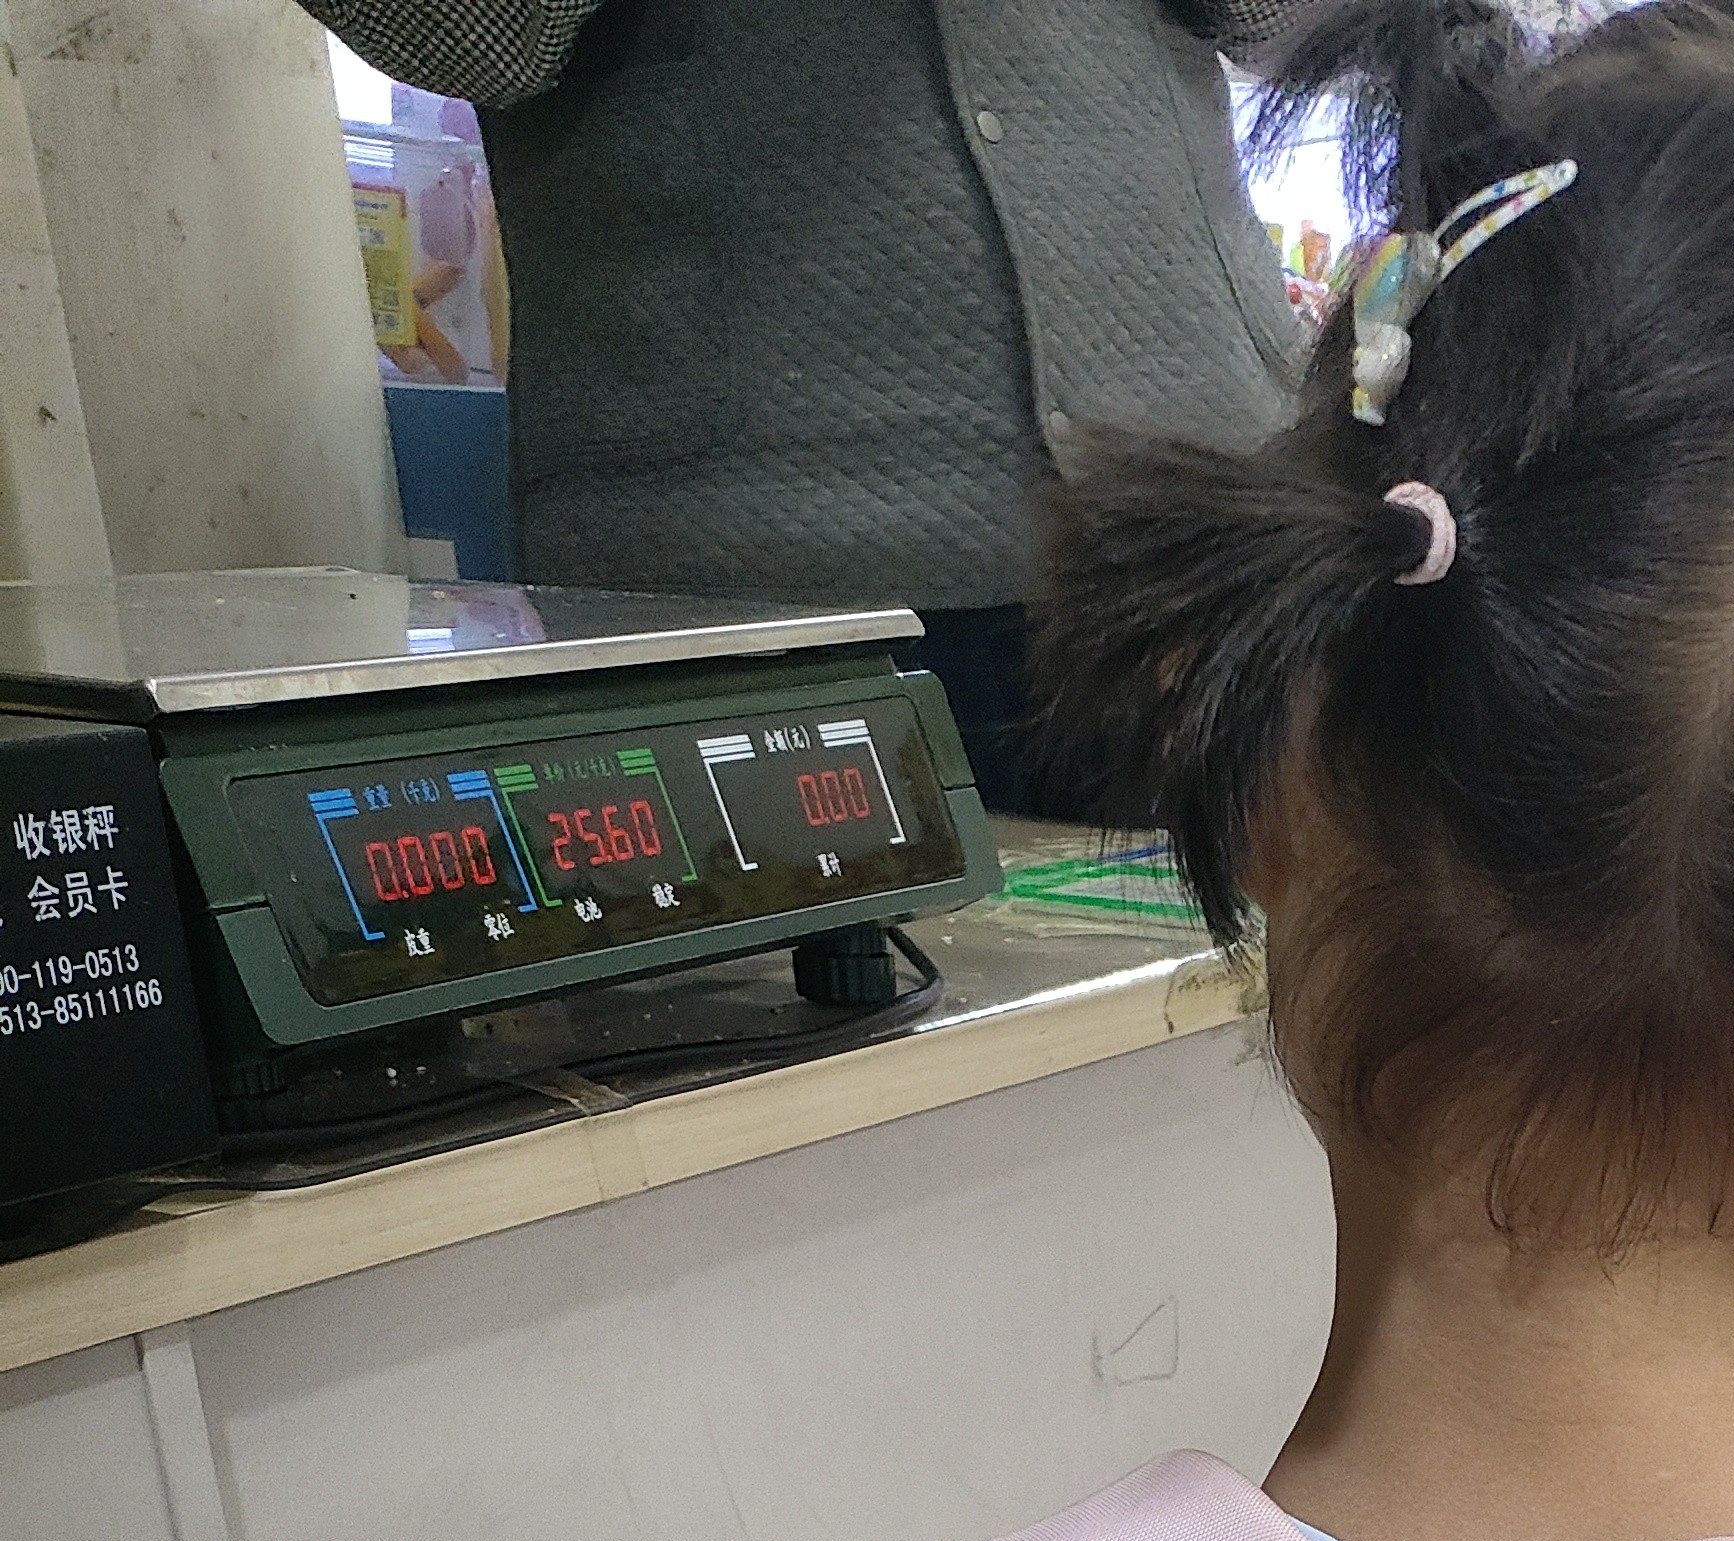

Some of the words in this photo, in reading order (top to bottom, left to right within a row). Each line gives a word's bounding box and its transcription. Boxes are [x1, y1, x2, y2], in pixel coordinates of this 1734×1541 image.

[13, 804, 119, 860] 收银秤
[365, 825, 497, 901] 0.000
[548, 800, 662, 871] 25.60
[27, 865, 129, 922] 会员卡
